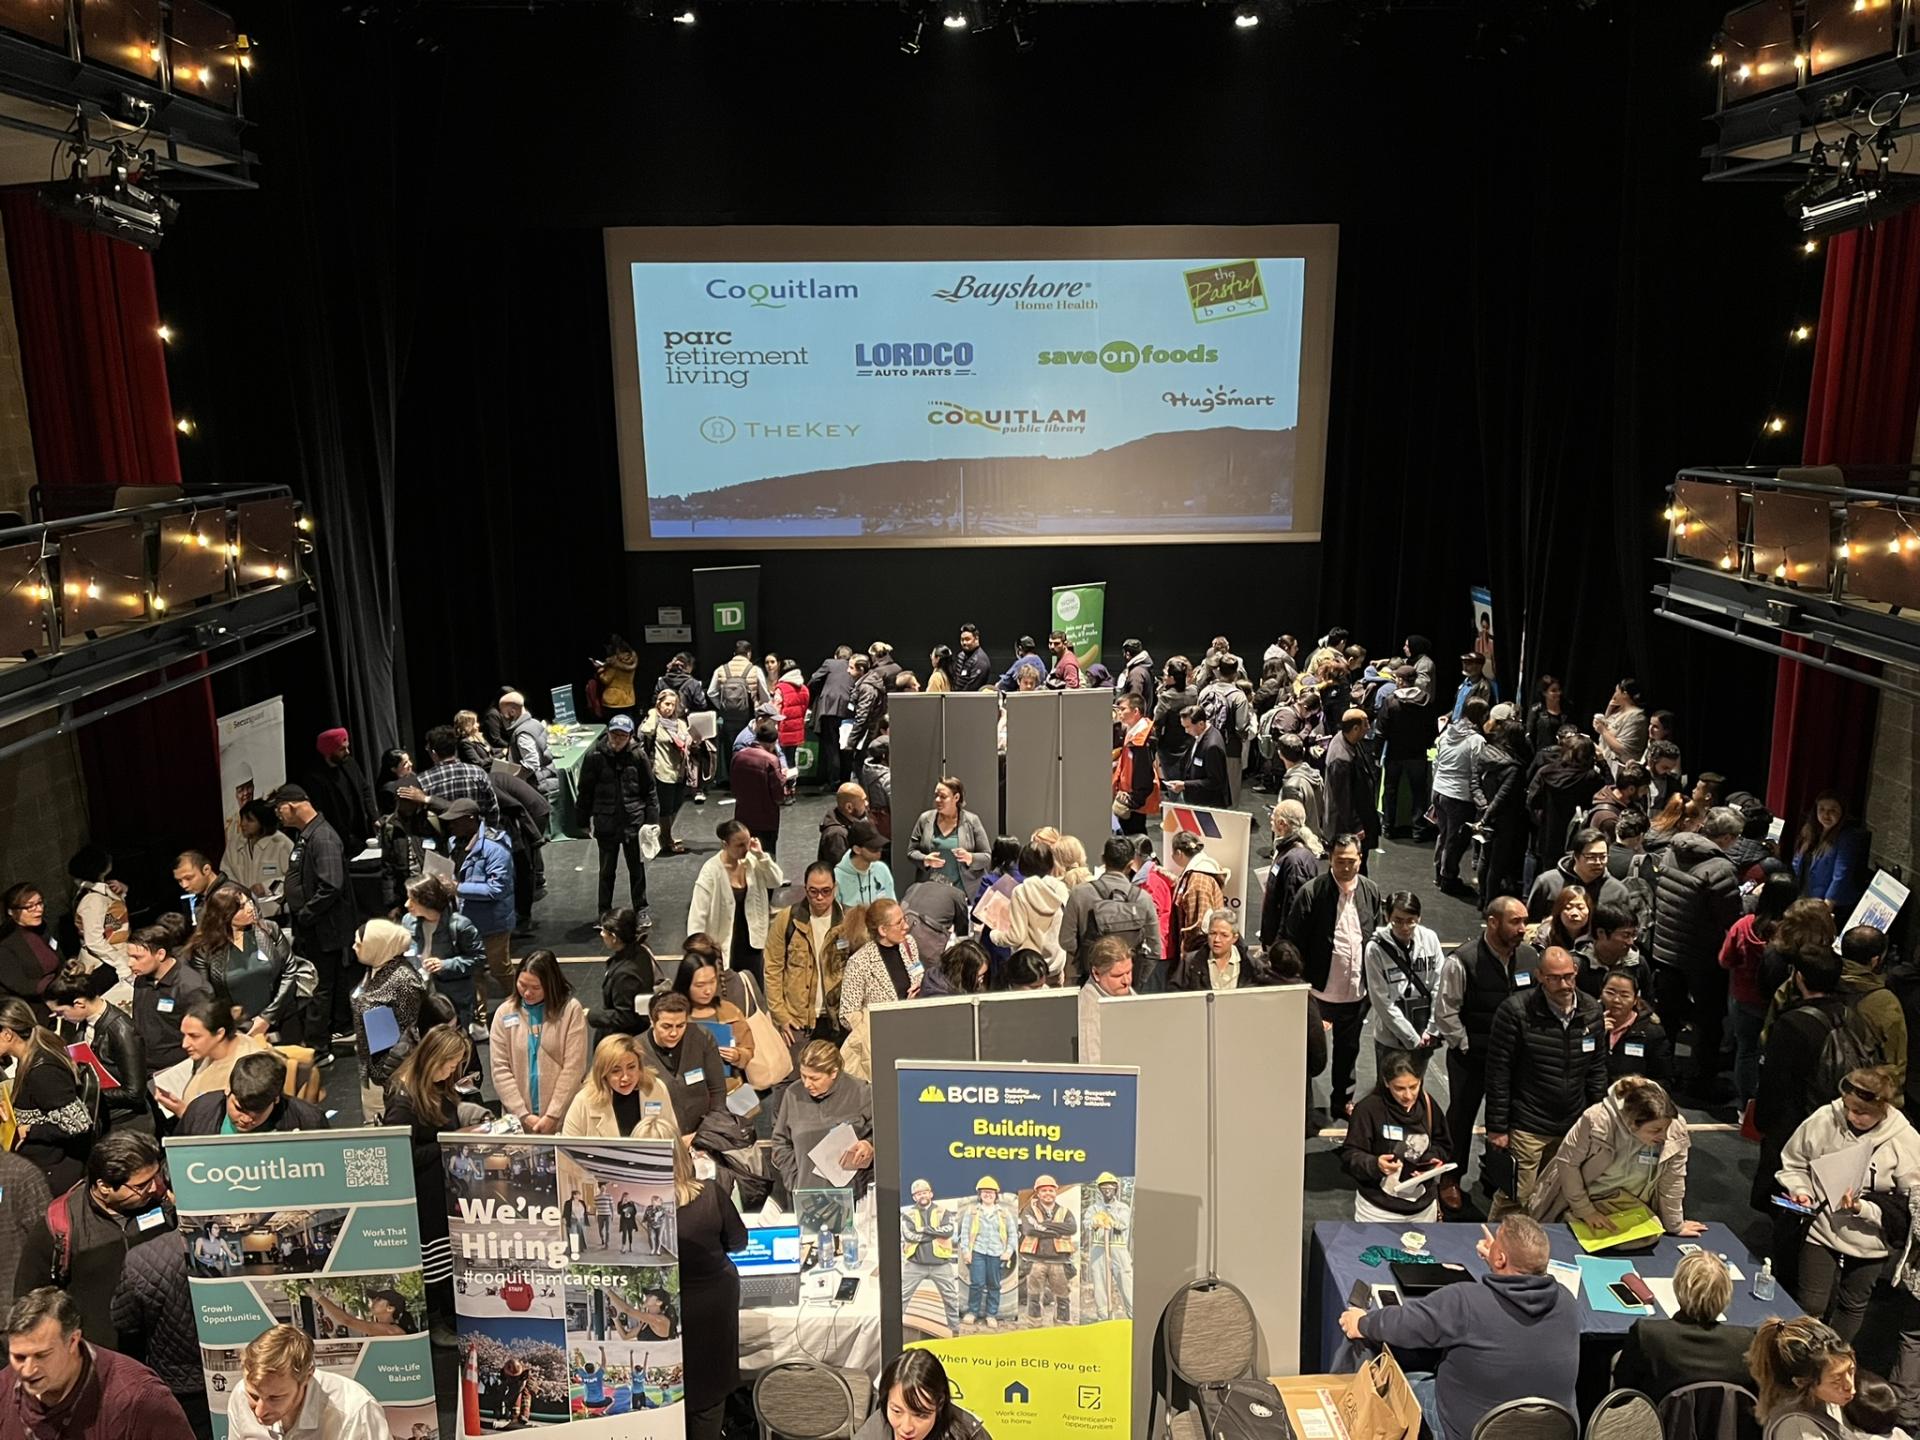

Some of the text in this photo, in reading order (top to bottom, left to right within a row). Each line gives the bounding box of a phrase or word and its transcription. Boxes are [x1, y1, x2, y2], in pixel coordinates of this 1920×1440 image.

[1189, 272, 1258, 308] Pastry
[1014, 300, 1098, 311] Home Health
[664, 331, 732, 349] parc
[665, 347, 808, 365] retirement
[855, 342, 974, 367] LORDCO
[1037, 343, 1219, 366] save on foods
[666, 366, 749, 389] living
[875, 368, 952, 378] AUTO PARTS
[1161, 387, 1275, 413] HugSmart
[927, 409, 1086, 427] COQUITLAM
[1002, 423, 1086, 435] public library
[716, 607, 742, 626] TD
[947, 1086, 1000, 1103] BCIB
[973, 1118, 1061, 1141] Building
[949, 1141, 1086, 1162] Careers Here
[458, 1197, 562, 1225] We're
[362, 1227, 407, 1237] Work That
[373, 1239, 408, 1247] Matters
[461, 1233, 581, 1269] Hiring!
[463, 1269, 628, 1287] #coquitlamcareers
[201, 1304, 233, 1313] Growth
[202, 1313, 261, 1325] Opportunities
[377, 1363, 421, 1372] Work-Life
[971, 1356, 992, 1366] you
[995, 1357, 1017, 1369] join
[1021, 1358, 1050, 1369] BCIB
[1053, 1361, 1074, 1371] you
[1078, 1363, 1101, 1373] get:
[388, 1374, 422, 1382] Balance
[1062, 1413, 1117, 1423] Apprenticeship
[1065, 1421, 1113, 1430] opportunities
